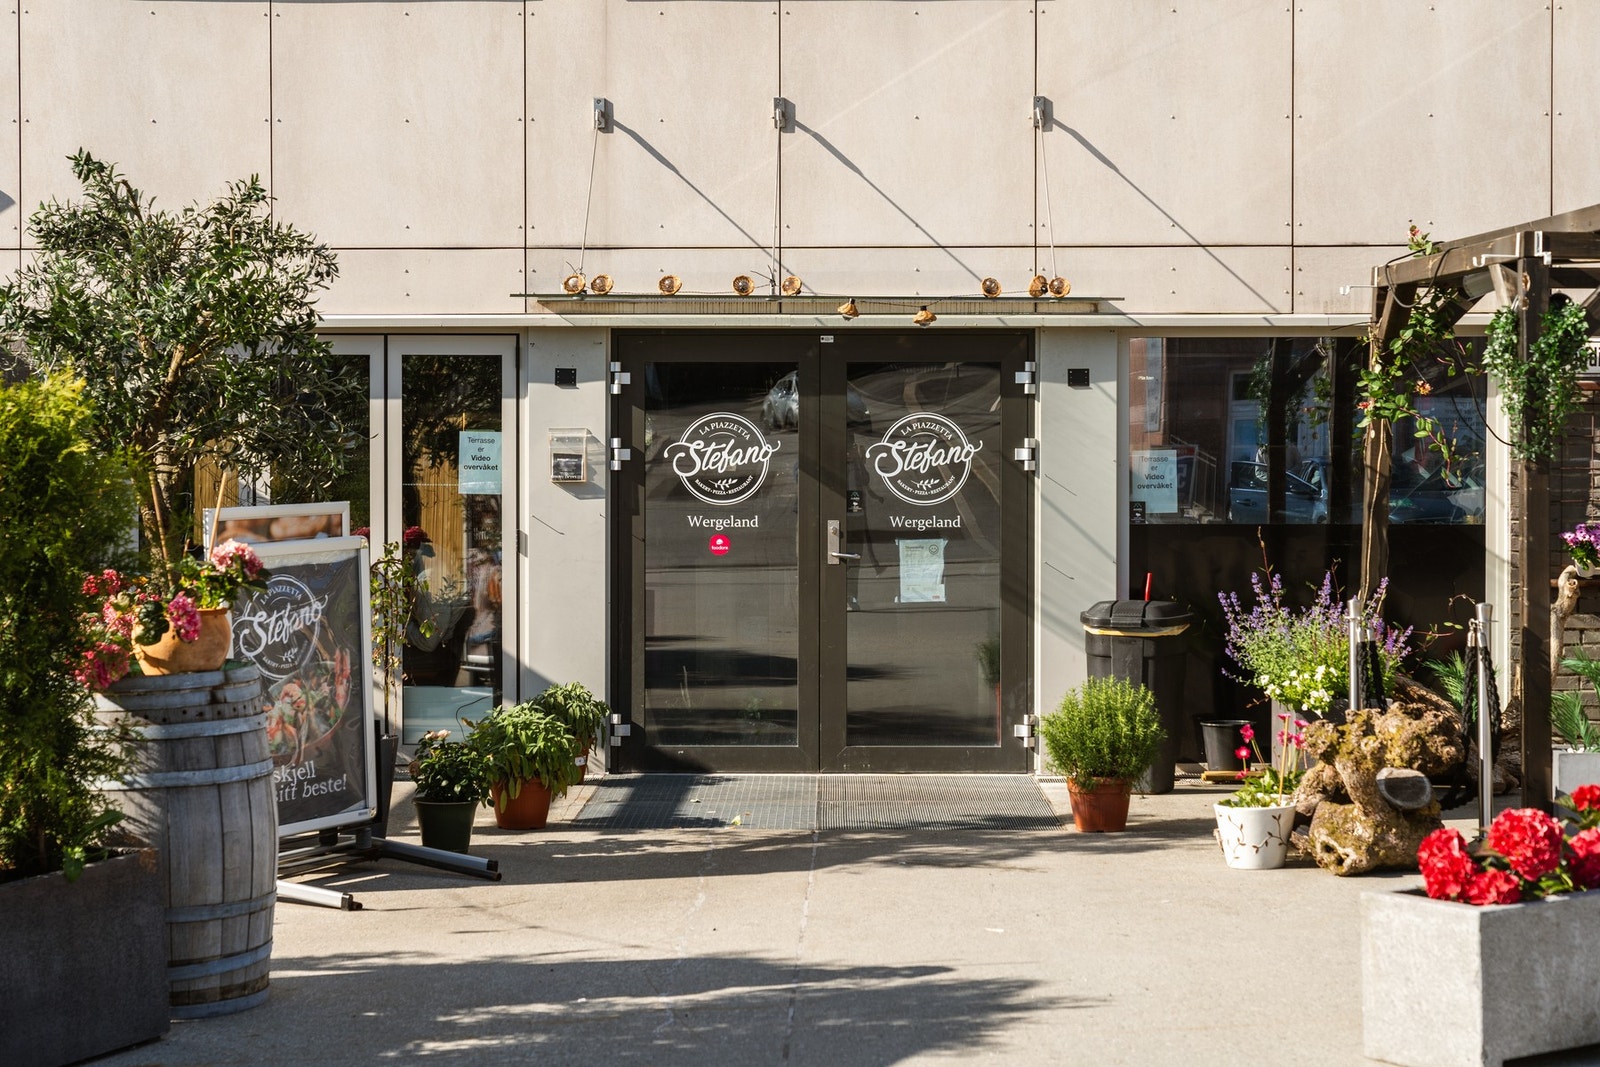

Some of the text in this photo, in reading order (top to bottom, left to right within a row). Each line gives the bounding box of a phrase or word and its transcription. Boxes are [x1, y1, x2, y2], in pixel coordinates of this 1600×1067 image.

[467, 436, 496, 444] Terrasse
[699, 421, 751, 441] LA PIAZZETTA
[901, 421, 953, 441] LA PIAZZETTA
[471, 454, 491, 462] Video
[663, 438, 781, 477] Stefano
[865, 438, 983, 478] Stefano
[1141, 455, 1169, 463] Terrasse
[1137, 482, 1173, 490] overvåket
[687, 515, 759, 531] Wergeland
[889, 515, 961, 532] Wergeland
[260, 585, 302, 605] LA PIAZZETTA
[231, 594, 328, 657] Stefano
[302, 773, 347, 798] beste!
